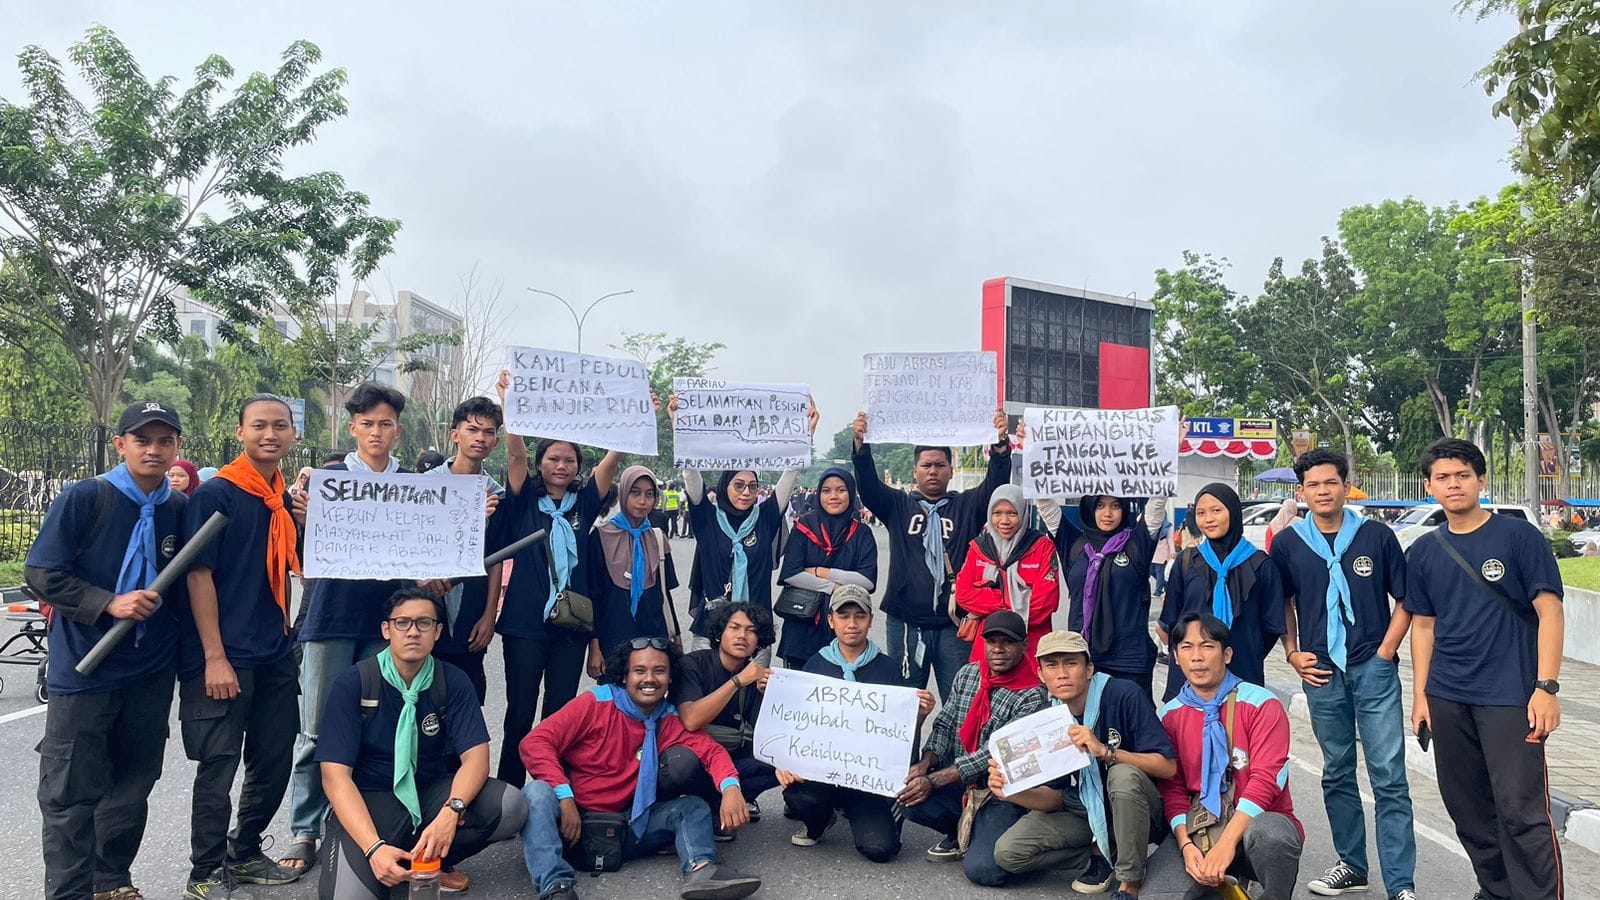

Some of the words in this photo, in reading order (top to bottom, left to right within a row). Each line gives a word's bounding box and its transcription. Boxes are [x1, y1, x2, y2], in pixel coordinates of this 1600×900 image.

[514, 351, 565, 373] KAMI
[580, 358, 646, 380] PEDULI
[869, 356, 896, 370] LAJU
[903, 357, 947, 370] ABRASI
[513, 376, 606, 395] BENCANA
[676, 378, 726, 389] #PARIAU
[866, 374, 919, 387] TERJADI
[929, 375, 941, 388] DI
[950, 376, 973, 390] KAB
[516, 396, 594, 415] BANJIR
[606, 397, 650, 414] RIAU
[676, 392, 763, 410] SELAMATKAN
[769, 394, 808, 413] PESISIR
[959, 393, 993, 408] RIAU
[676, 413, 707, 427] KITA
[713, 413, 742, 428] DARI
[1044, 409, 1087, 423] KITA
[1097, 408, 1166, 423] HARUS
[1031, 422, 1155, 442] MEMBANGUN
[1193, 421, 1213, 433] KTL
[1042, 442, 1127, 461] TANGGUL
[1131, 442, 1159, 461] KE
[1030, 460, 1108, 478] BERANIAN
[1115, 461, 1177, 477] UNTUK
[319, 477, 447, 505] SELAMATKAN
[1035, 477, 1115, 495] MENAHAN
[1121, 479, 1178, 497] BANJIR
[321, 503, 377, 525] KEBUN
[314, 523, 412, 542] MASYARAKAT
[418, 531, 448, 545] DARI
[907, 514, 954, 540] GP
[314, 540, 380, 560] DAMPAK
[388, 545, 444, 558] ABRASI
[806, 686, 887, 713] ABRASI
[770, 703, 852, 731] Mengubah
[788, 735, 883, 769] Kehidupan
